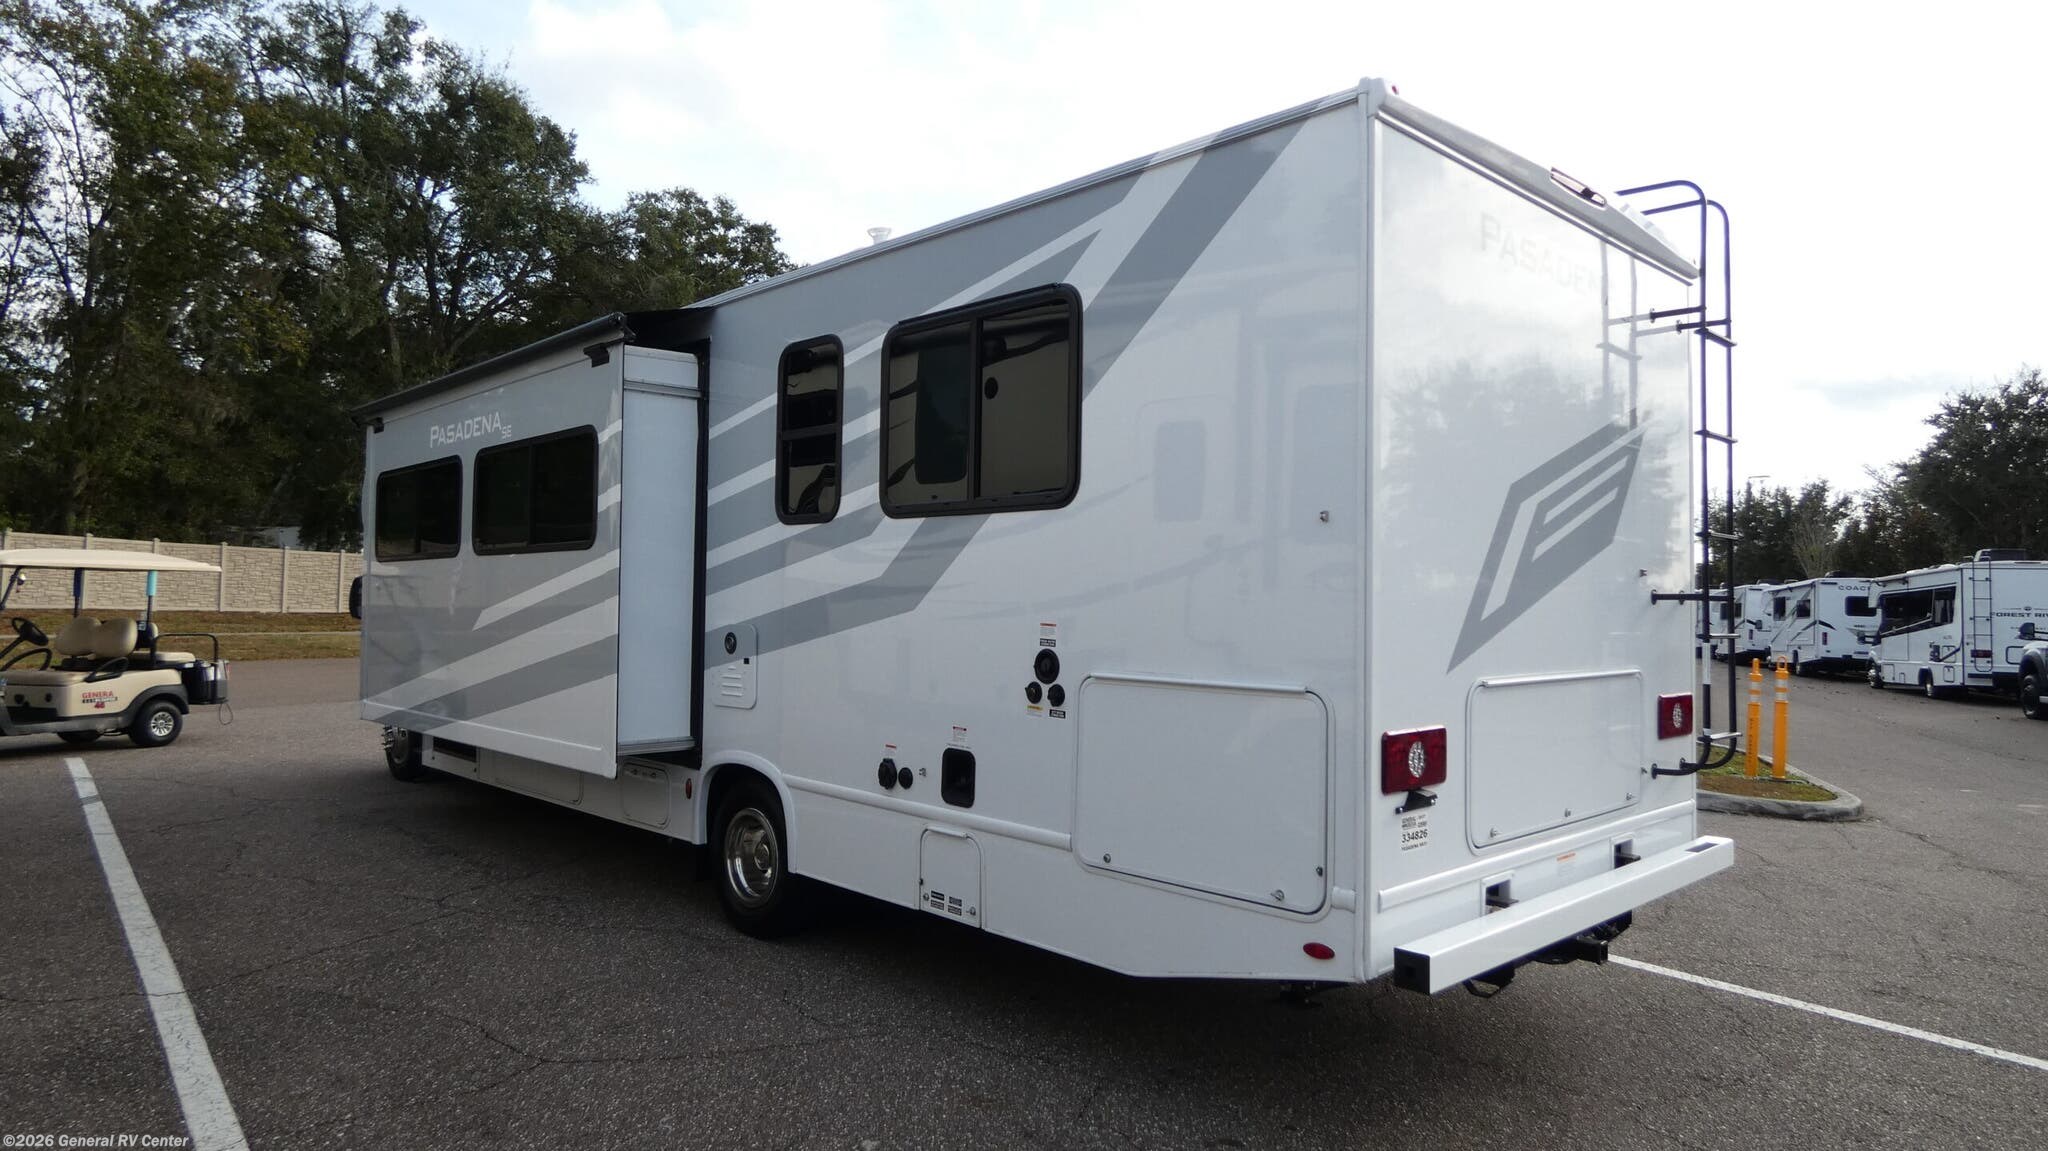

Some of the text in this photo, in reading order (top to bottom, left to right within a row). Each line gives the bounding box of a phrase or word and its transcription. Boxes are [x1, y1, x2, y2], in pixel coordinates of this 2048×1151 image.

[1479, 209, 1614, 302] PASADEN
[429, 411, 512, 448] PASADENA SE
[1402, 828, 1428, 844] 334826
